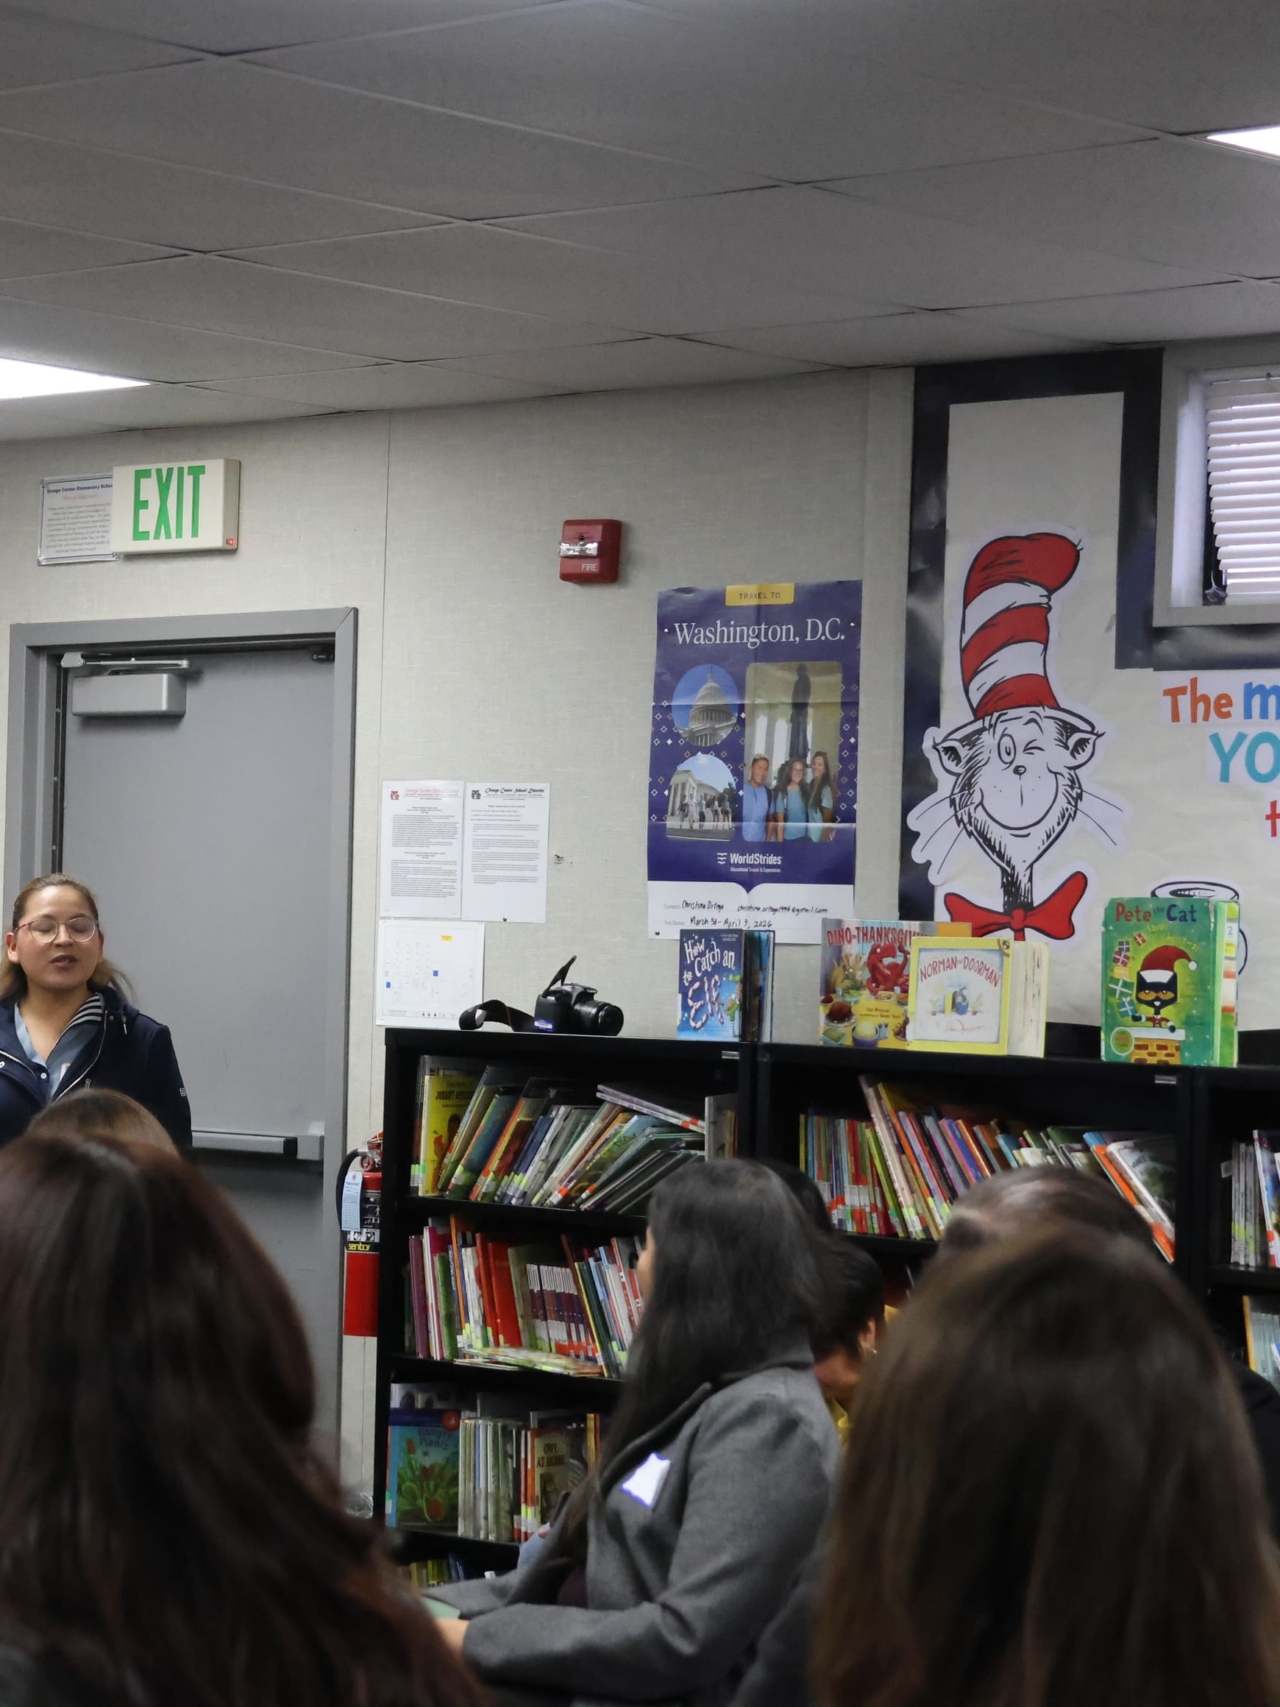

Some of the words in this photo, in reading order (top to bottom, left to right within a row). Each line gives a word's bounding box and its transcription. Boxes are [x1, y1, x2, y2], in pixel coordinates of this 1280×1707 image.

[132, 465, 206, 541] EXIT
[581, 563, 598, 571] FIRE
[739, 591, 768, 600] TRAVEL
[674, 620, 799, 649] Washington,
[805, 617, 846, 641] D.C.
[1162, 676, 1233, 724] The
[730, 853, 782, 865] WorldStrides
[690, 916, 709, 926] March
[753, 920, 773, 928] 2026
[1115, 902, 1152, 922] Pete
[1166, 904, 1197, 923] Cat
[827, 926, 933, 948] DINO-THANKSGIV
[722, 950, 736, 971] an
[919, 956, 957, 983] NORMAN
[963, 956, 1001, 988] DOORMAN
[687, 973, 725, 1030] Elf
[348, 1242, 371, 1251] sentry
